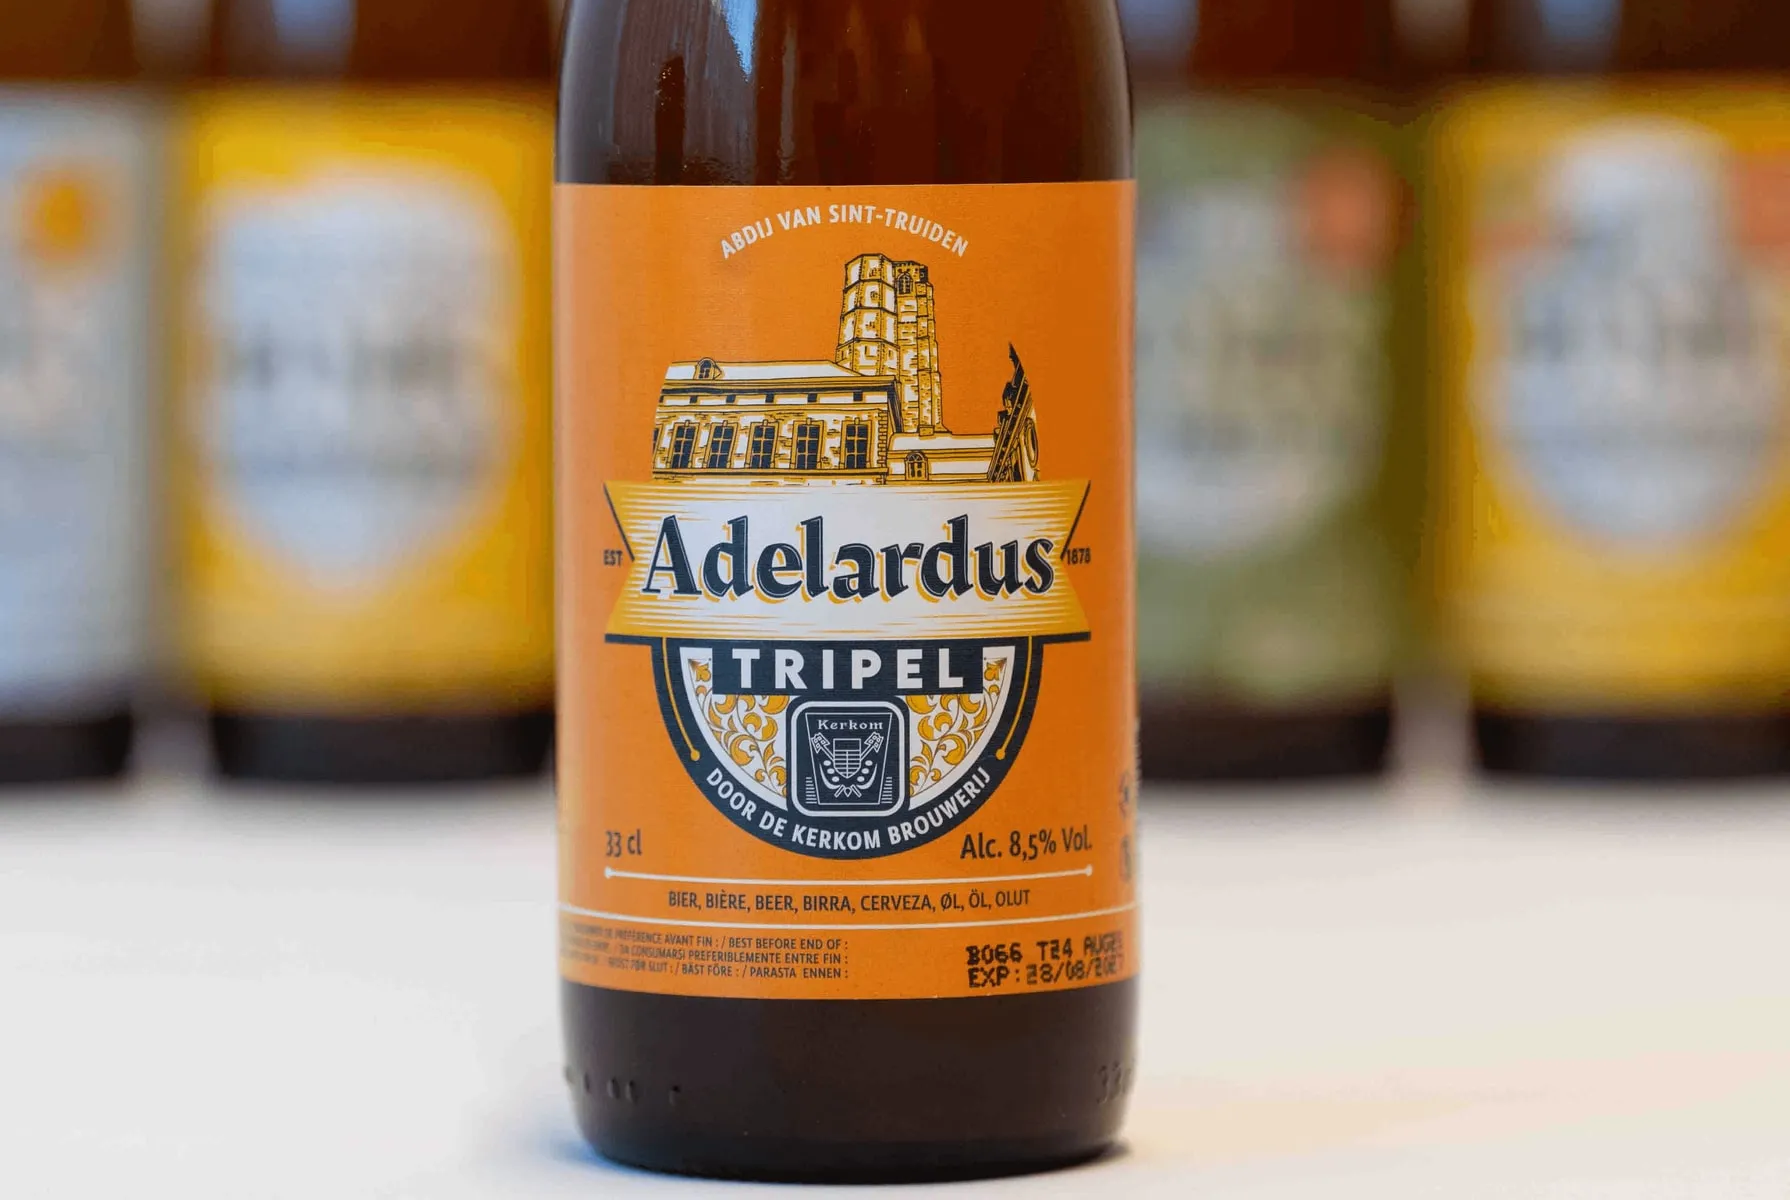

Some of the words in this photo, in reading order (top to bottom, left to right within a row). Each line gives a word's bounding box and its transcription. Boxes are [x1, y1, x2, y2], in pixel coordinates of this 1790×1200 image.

[720, 217, 774, 259] ABDIJ
[777, 206, 821, 231] VAN
[828, 204, 969, 258] SINT-TRUIDEN
[603, 549, 623, 566] EST
[641, 514, 1054, 603] Adelardus
[1066, 548, 1091, 565] 1878
[732, 648, 964, 689] TRIPEL
[817, 718, 884, 731] Kerkom
[706, 768, 760, 821] DOOR
[758, 813, 788, 838] DE
[791, 824, 882, 851] KERKOM
[887, 766, 991, 846] BROUWERIJ
[605, 830, 622, 857] 33
[627, 828, 642, 856] cl
[960, 832, 1002, 860] Alc.
[1008, 827, 1057, 862] 8,5%
[1061, 824, 1093, 852] Vol.
[668, 890, 701, 910] BIER,
[705, 889, 751, 913] BIÈRE,
[755, 894, 799, 914] BEER,
[803, 895, 857, 915] BIRRA,
[860, 894, 936, 912] CERVEZA,
[940, 892, 965, 912] ØL,
[968, 889, 992, 910] ÖL,
[995, 889, 1031, 907] OLUT
[664, 932, 694, 946] AVANT
[696, 935, 713, 946] FIN
[729, 936, 752, 949] BEST
[755, 937, 796, 949] BEFORE
[800, 939, 823, 950] END
[826, 939, 842, 950] OF
[689, 950, 781, 964] PREFERIBLEMENTE
[785, 953, 819, 964] ENTRE
[823, 953, 841, 964] FIN
[707, 963, 732, 977] FÖRE
[750, 966, 797, 978] PARASTA
[803, 967, 841, 979] ENNEN
